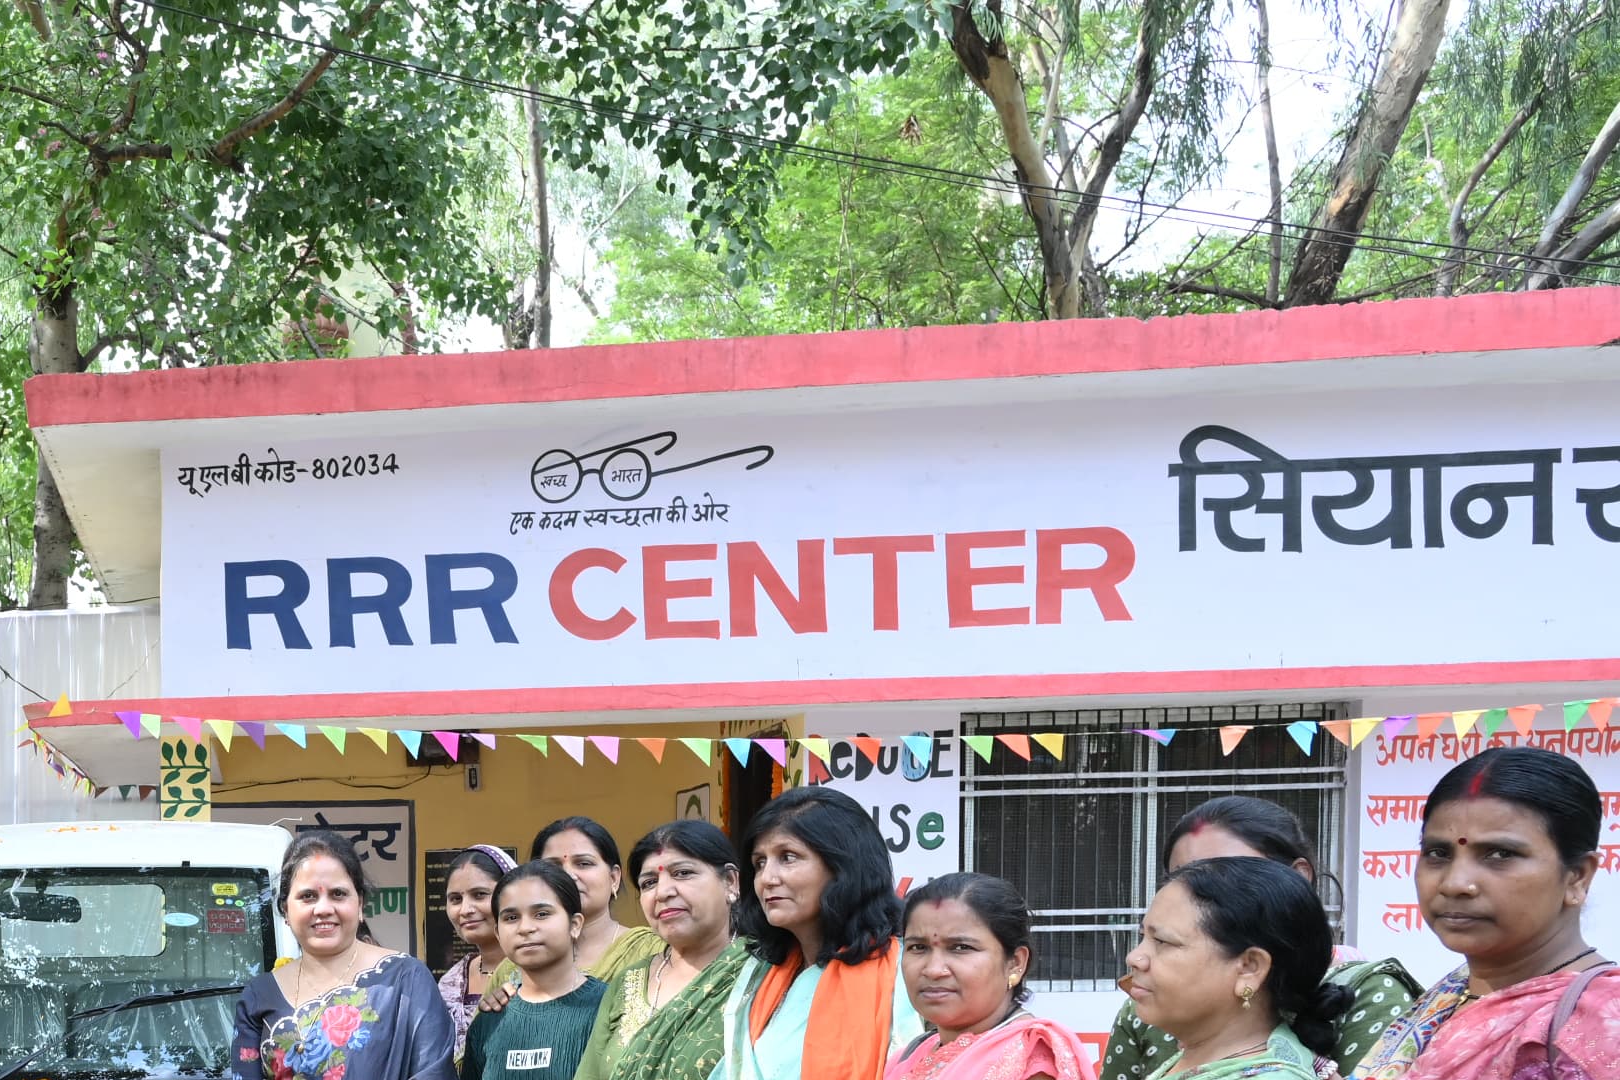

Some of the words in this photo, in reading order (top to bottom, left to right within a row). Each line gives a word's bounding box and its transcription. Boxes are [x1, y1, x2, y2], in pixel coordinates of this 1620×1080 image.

[611, 468, 644, 484] भारत
[1168, 425, 1563, 553] सियान
[510, 511, 535, 535] एक
[538, 510, 581, 530] कदम
[584, 507, 664, 529] स्वच्छता
[666, 496, 689, 524] की
[692, 492, 730, 523] ओर
[224, 551, 520, 650] RRR
[549, 526, 1135, 641] CENTER
[508, 1052, 527, 1067] NEW
[530, 1050, 549, 1066] YORK
